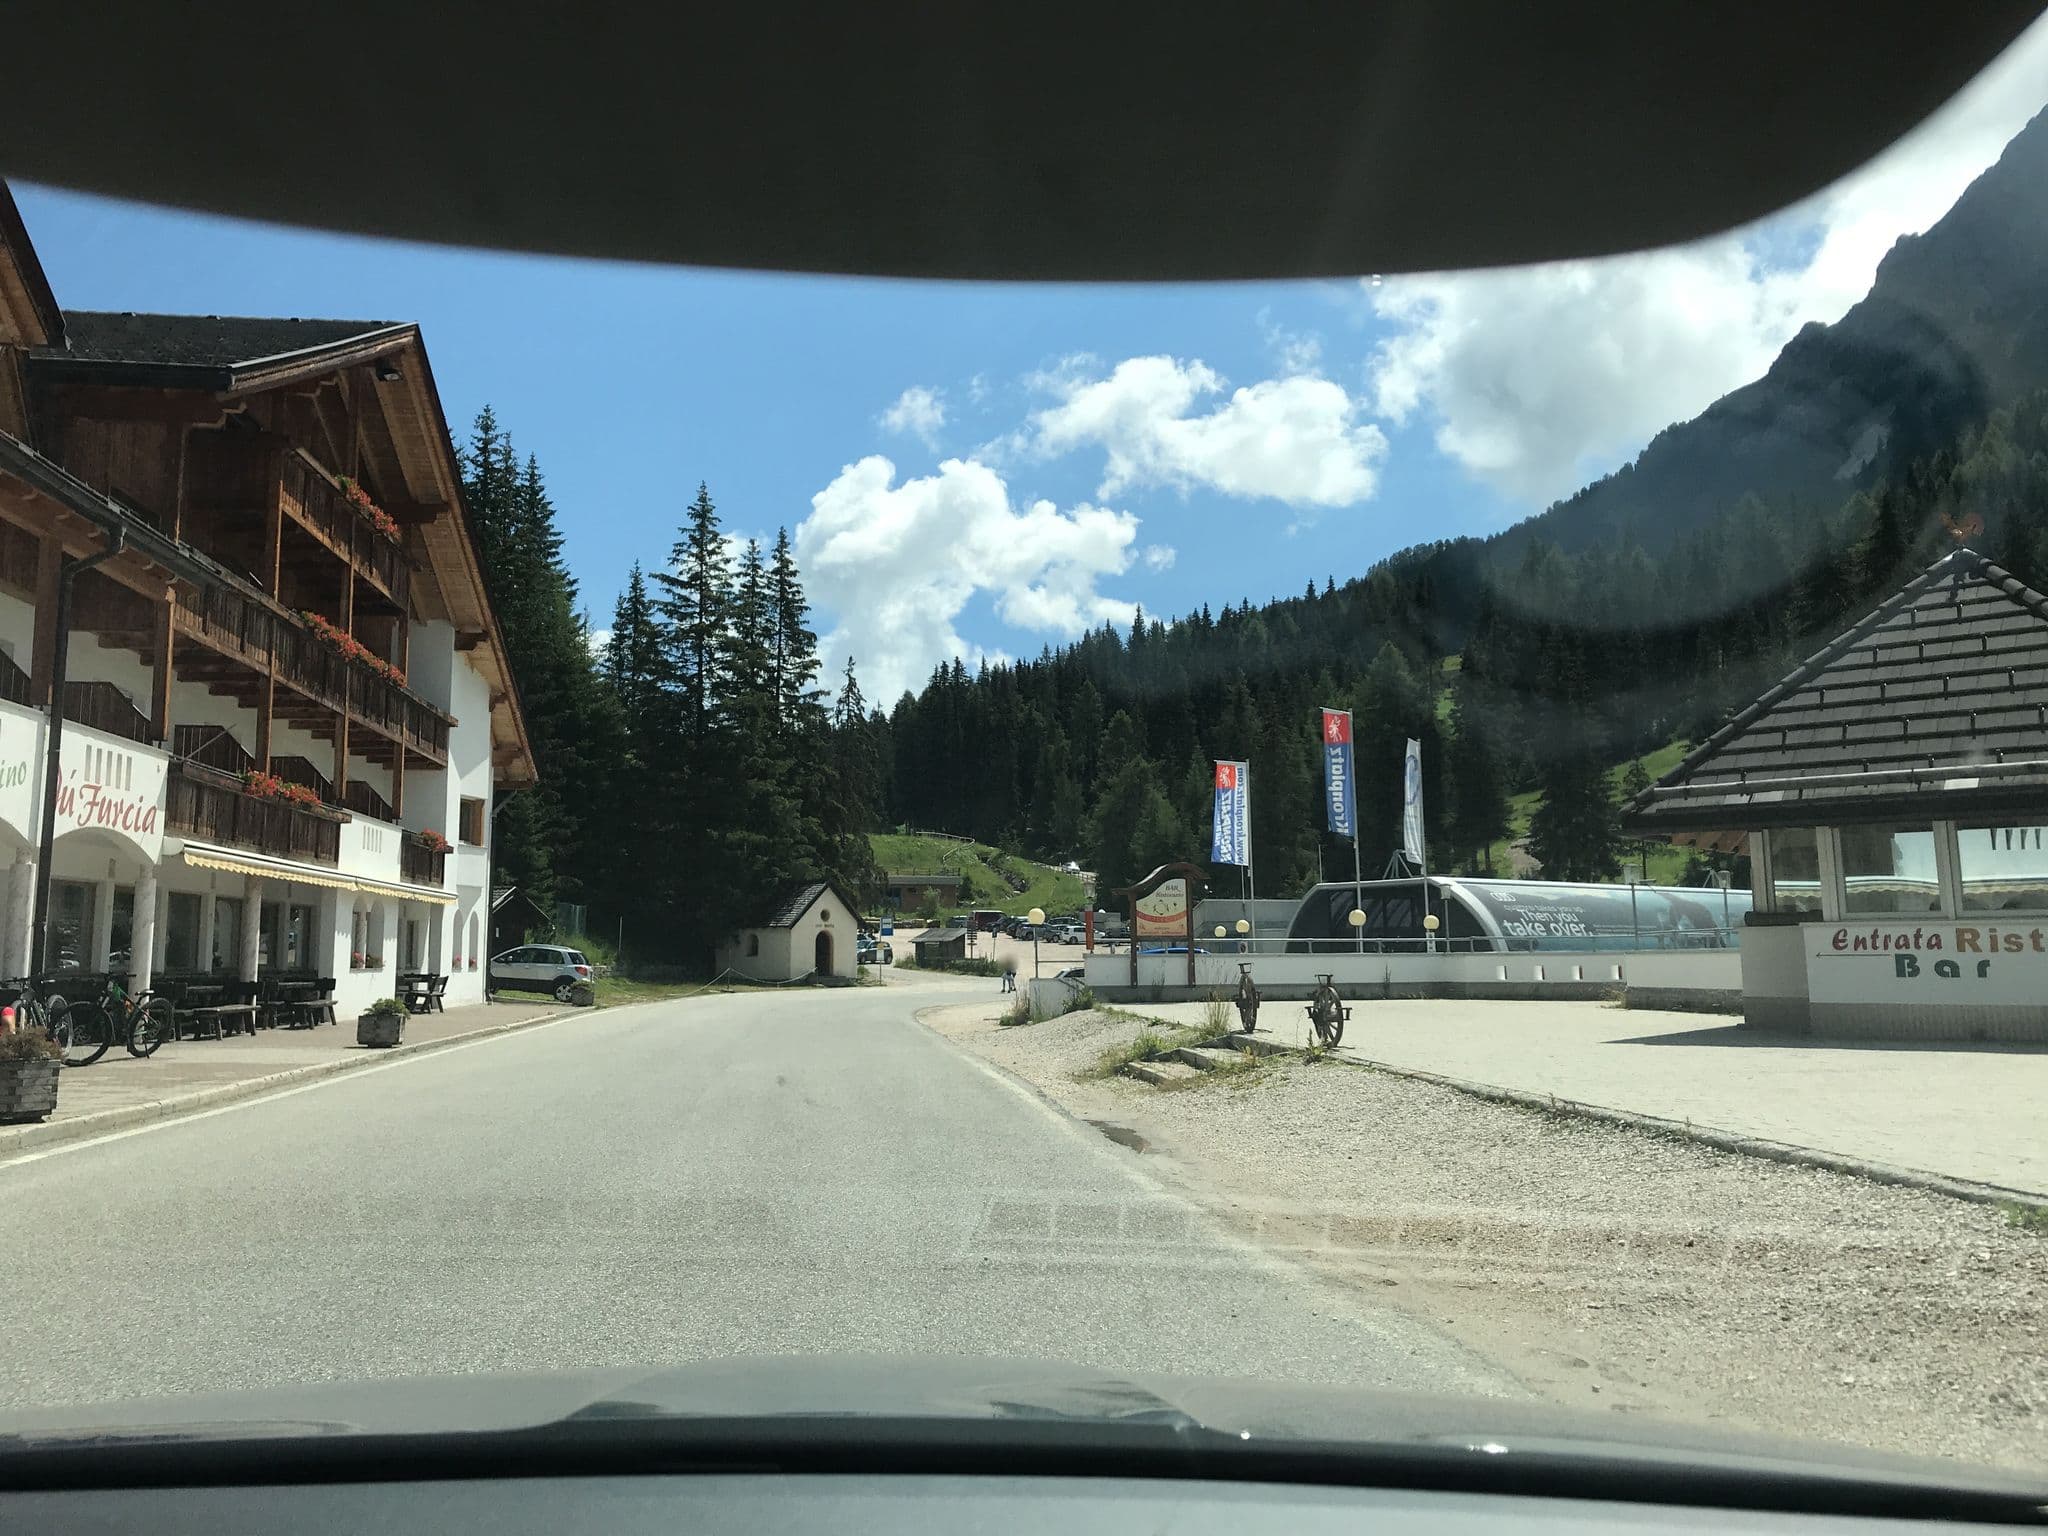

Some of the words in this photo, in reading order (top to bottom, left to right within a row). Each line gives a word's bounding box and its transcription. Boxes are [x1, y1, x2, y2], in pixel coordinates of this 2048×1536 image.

[77, 783, 158, 835] Furcia
[1503, 918, 1547, 937] take
[1550, 921, 1593, 937] over.
[1517, 908, 1554, 922] Then
[1554, 912, 1580, 926] you
[1832, 927, 1943, 951] Entrata
[1955, 927, 2046, 953] Rist
[1894, 953, 1991, 978] Bar
